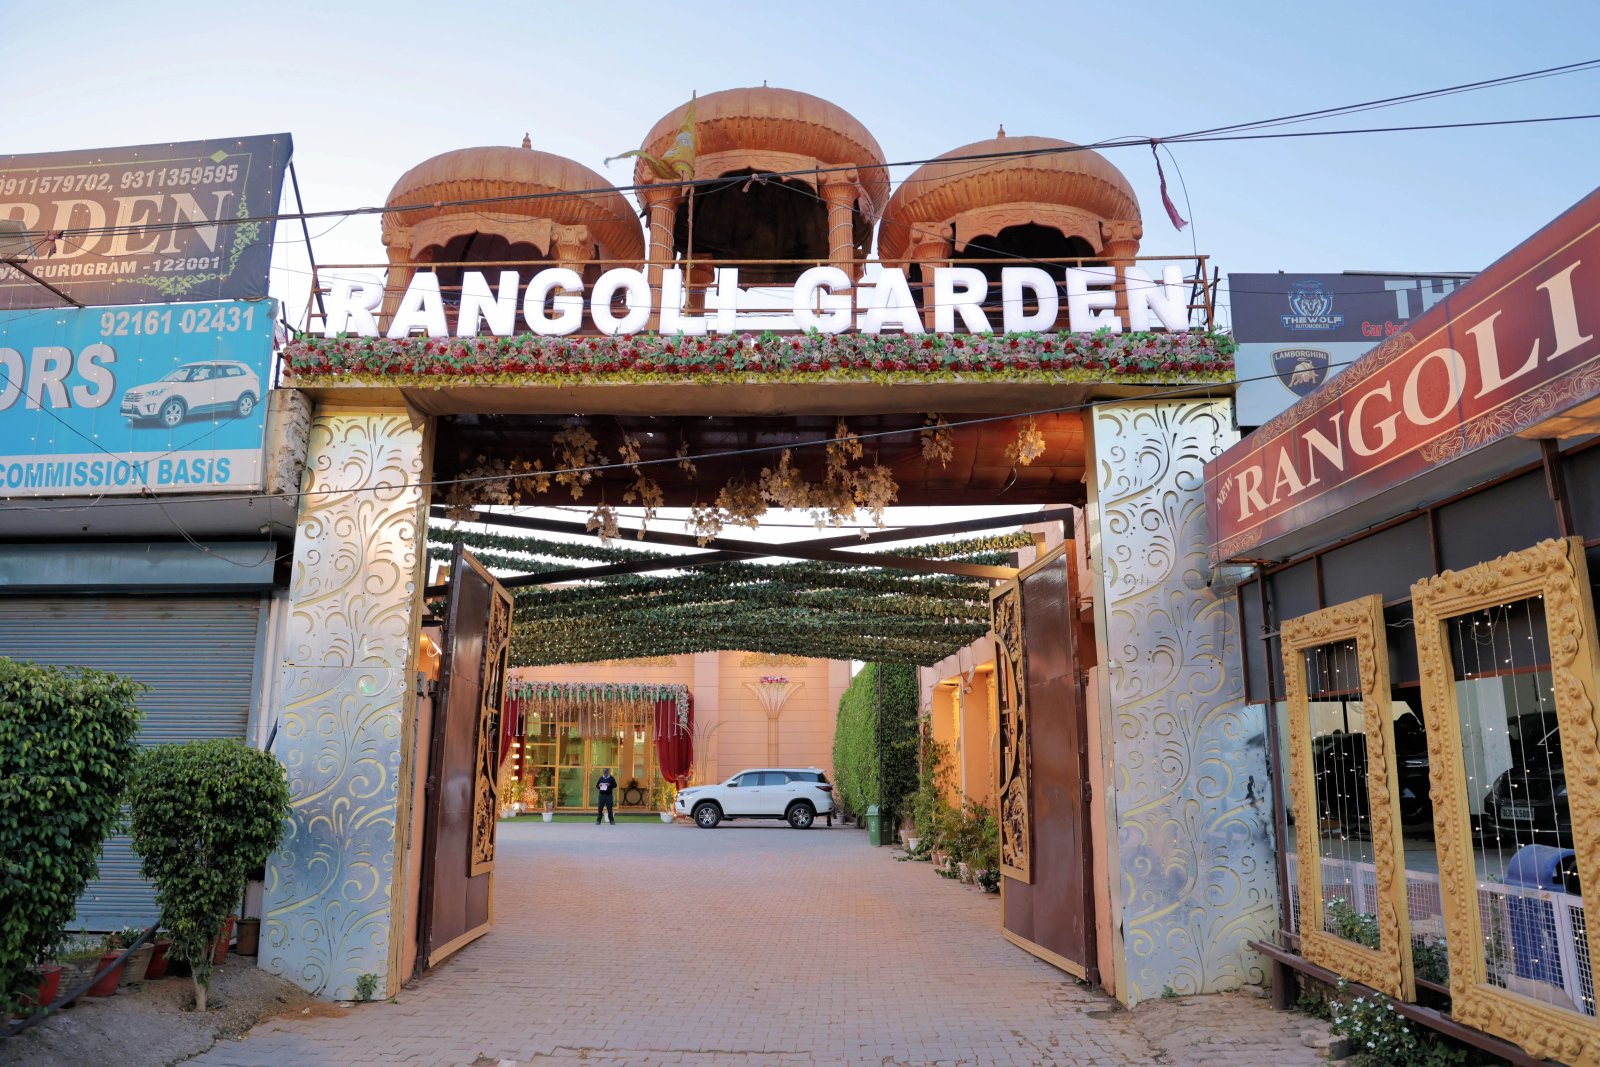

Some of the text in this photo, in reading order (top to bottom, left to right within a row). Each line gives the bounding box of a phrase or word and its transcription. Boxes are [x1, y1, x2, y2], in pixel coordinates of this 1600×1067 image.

[120, 164, 239, 189] 9311359595
[32, 260, 136, 278] GURUGRAM
[324, 264, 1190, 339] RANGOLI GARDEN
[1384, 279, 1470, 319] TH
[100, 306, 254, 336] 92161 02431
[1361, 321, 1383, 337] Car
[1275, 350, 1327, 361] LAMBORGHINI
[1216, 259, 1594, 523] NEW RANGOLI
[157, 457, 231, 485] BASIS
